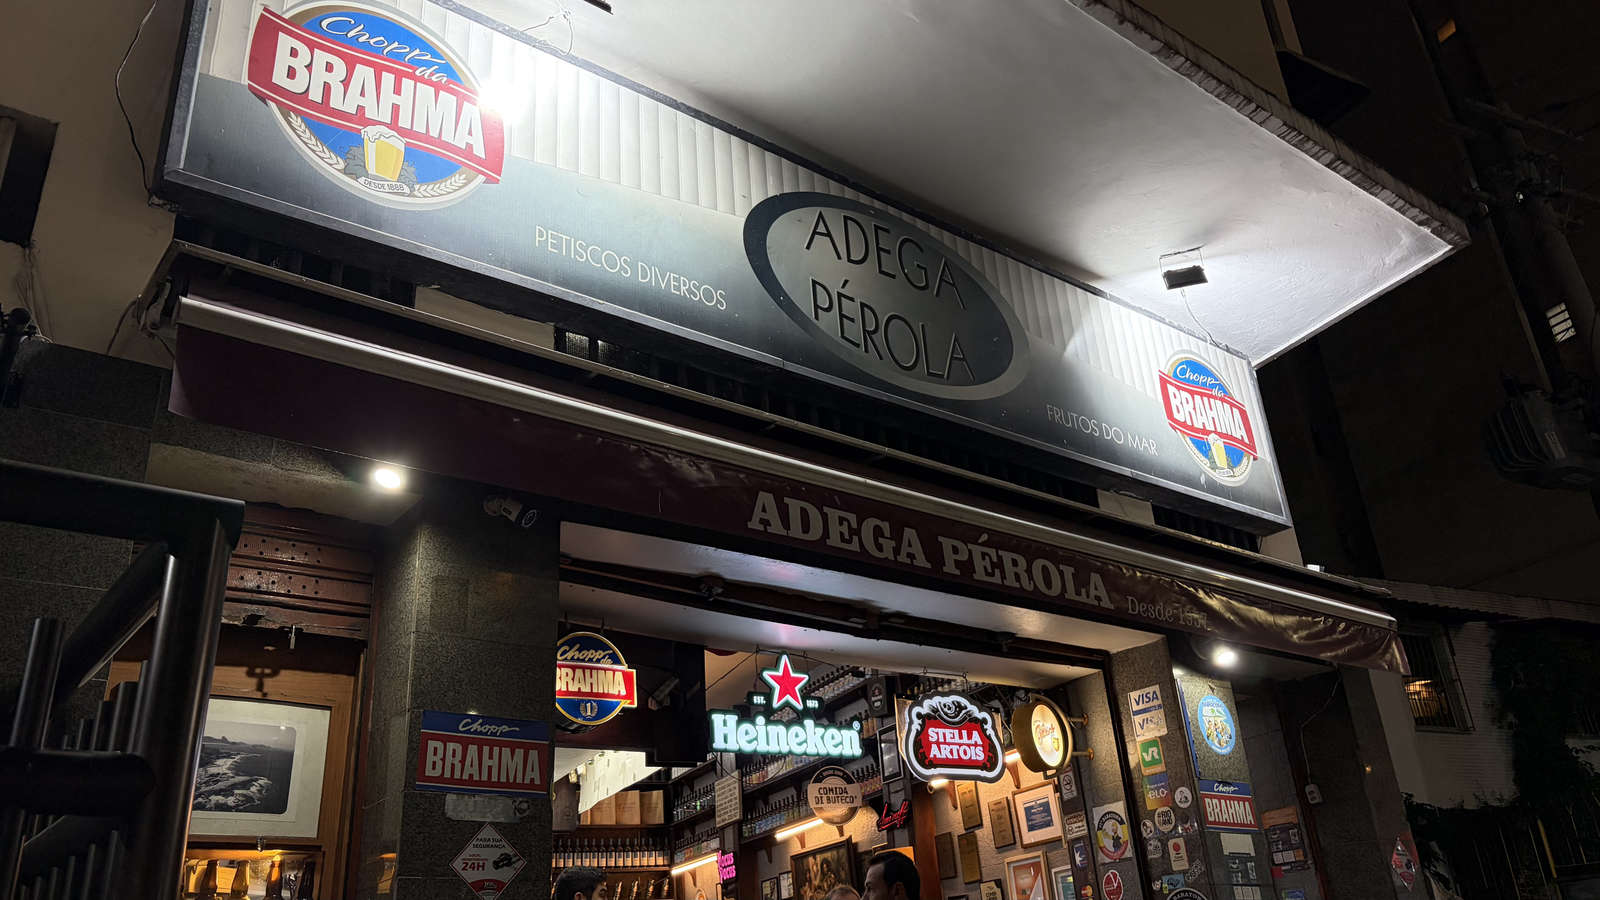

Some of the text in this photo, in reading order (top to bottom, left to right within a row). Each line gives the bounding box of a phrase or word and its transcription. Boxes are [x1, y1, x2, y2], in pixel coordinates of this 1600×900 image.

[320, 16, 448, 84] Chopp da
[270, 33, 486, 160] BRAHMA
[363, 178, 405, 192] DESDE 1888
[535, 225, 727, 310] PETISCOS DIVERSOS
[805, 209, 969, 309] ADEGA
[810, 279, 976, 382] PÉROLA
[1176, 364, 1225, 398] Chopp da
[1166, 383, 1250, 444] BRAHMA
[1046, 404, 1158, 456] FRUTOS DO MAR
[747, 491, 1114, 610] ADEGA PÉROLA
[1126, 596, 1174, 622] Desde
[557, 643, 613, 661] Chopp
[1133, 690, 1159, 706] VISA
[458, 718, 520, 736] Chopp
[711, 713, 862, 757] Heineken
[928, 727, 983, 745] STELLA
[425, 739, 541, 785] BRAHMA
[929, 744, 984, 761] ARTOIS
[817, 786, 849, 795] COMIDA
[1213, 783, 1240, 794] Chopp
[1204, 797, 1255, 825] BRAHMA
[461, 861, 486, 872] 24H
